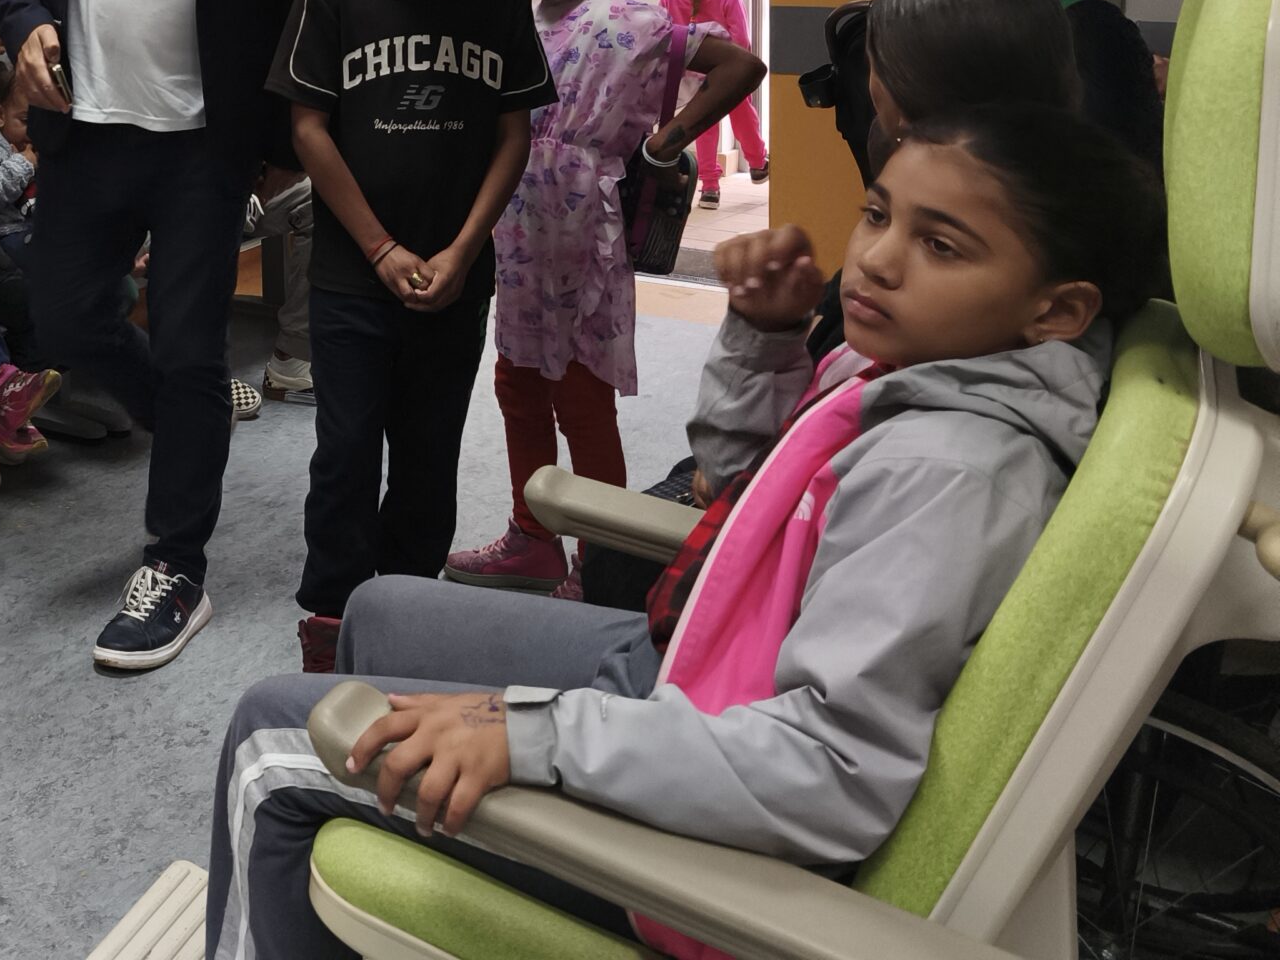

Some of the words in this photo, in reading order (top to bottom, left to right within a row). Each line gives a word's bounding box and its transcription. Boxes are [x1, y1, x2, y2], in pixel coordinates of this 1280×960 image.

[342, 34, 503, 90] CHICAGO
[373, 118, 441, 134] Unforgettable
[442, 120, 464, 132] 1986
